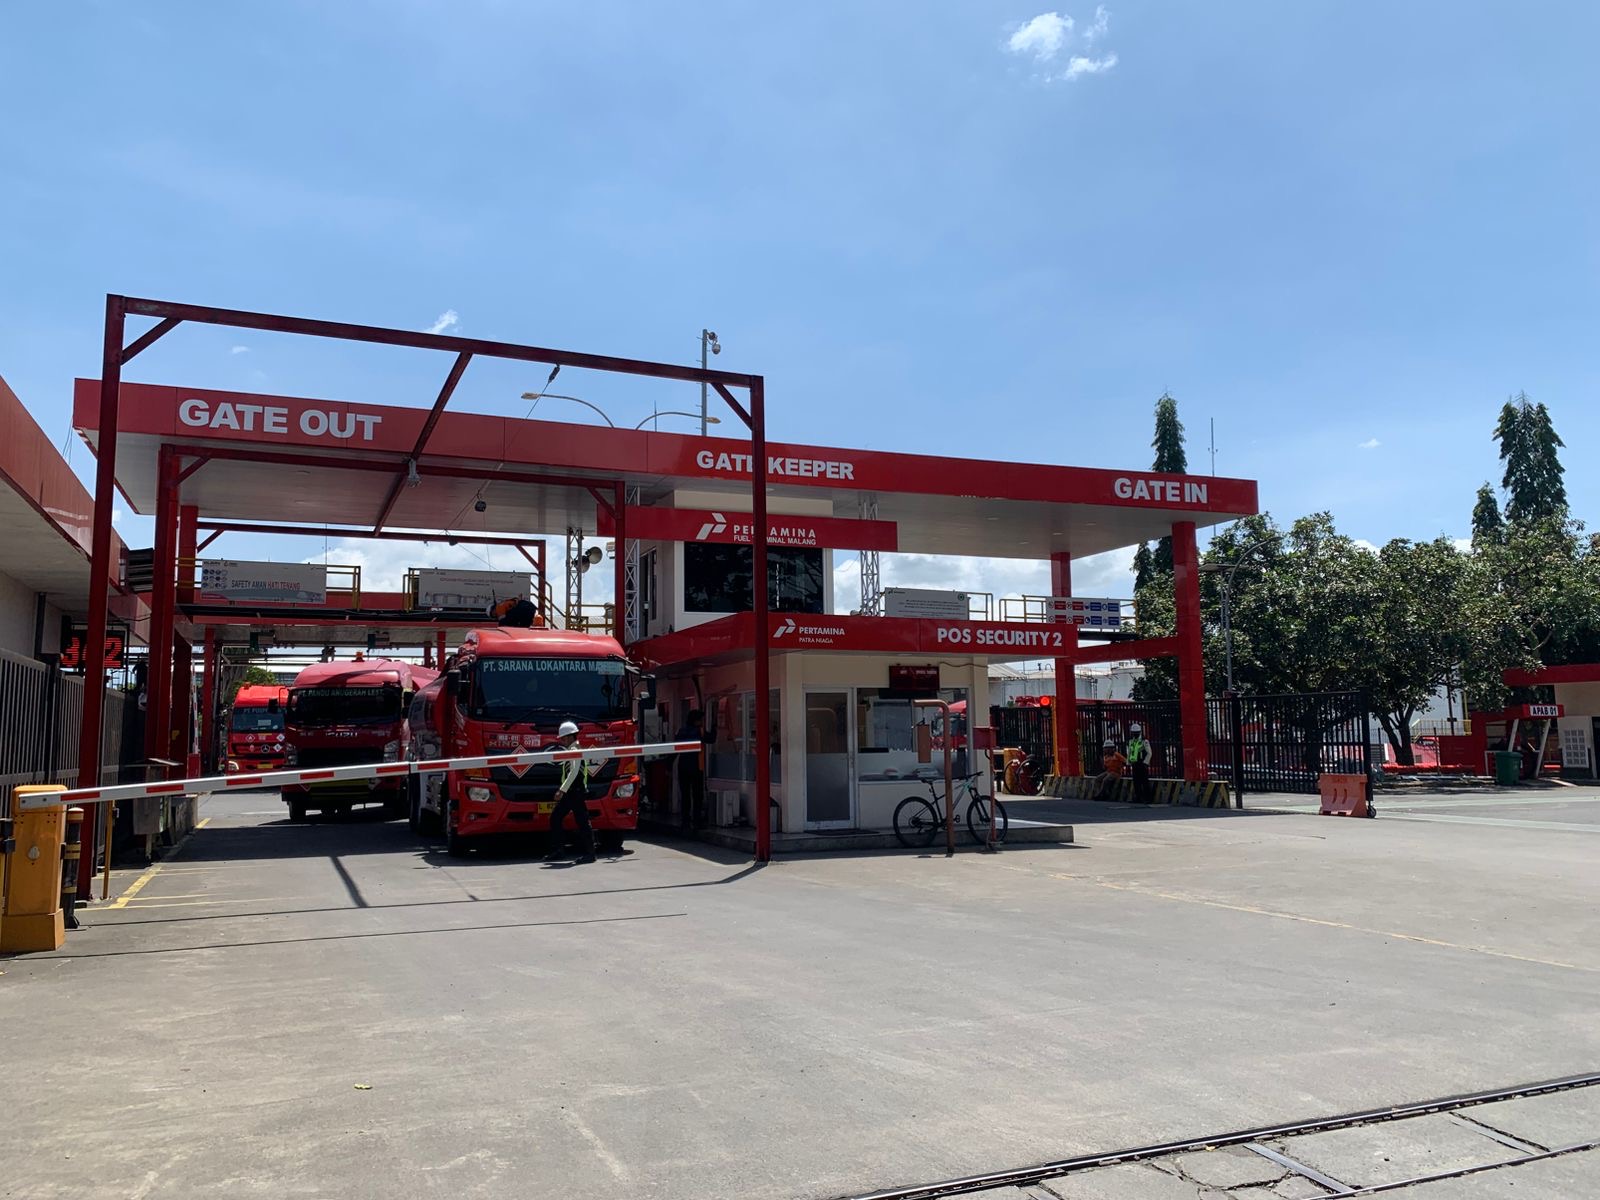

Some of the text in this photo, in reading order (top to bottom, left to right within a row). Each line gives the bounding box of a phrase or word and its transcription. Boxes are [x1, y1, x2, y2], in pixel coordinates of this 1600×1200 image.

[179, 398, 382, 441] GATE OUT
[768, 456, 855, 481] KEEPER
[1114, 477, 1208, 504] GATE IN
[733, 524, 816, 539] PEAMINA
[733, 534, 751, 543] FUEL
[787, 537, 817, 546] MALANG
[231, 579, 251, 589] SAFETY
[251, 580, 267, 590] AMAN
[799, 626, 846, 636] PERTAMINA
[937, 627, 1063, 647] POS SECURITY 2
[799, 636, 834, 645] PATRA NIAGA
[61, 636, 123, 668] 32
[482, 661, 496, 673] PT.
[498, 660, 534, 672] SARANA
[535, 660, 587, 672] LOKANTARA
